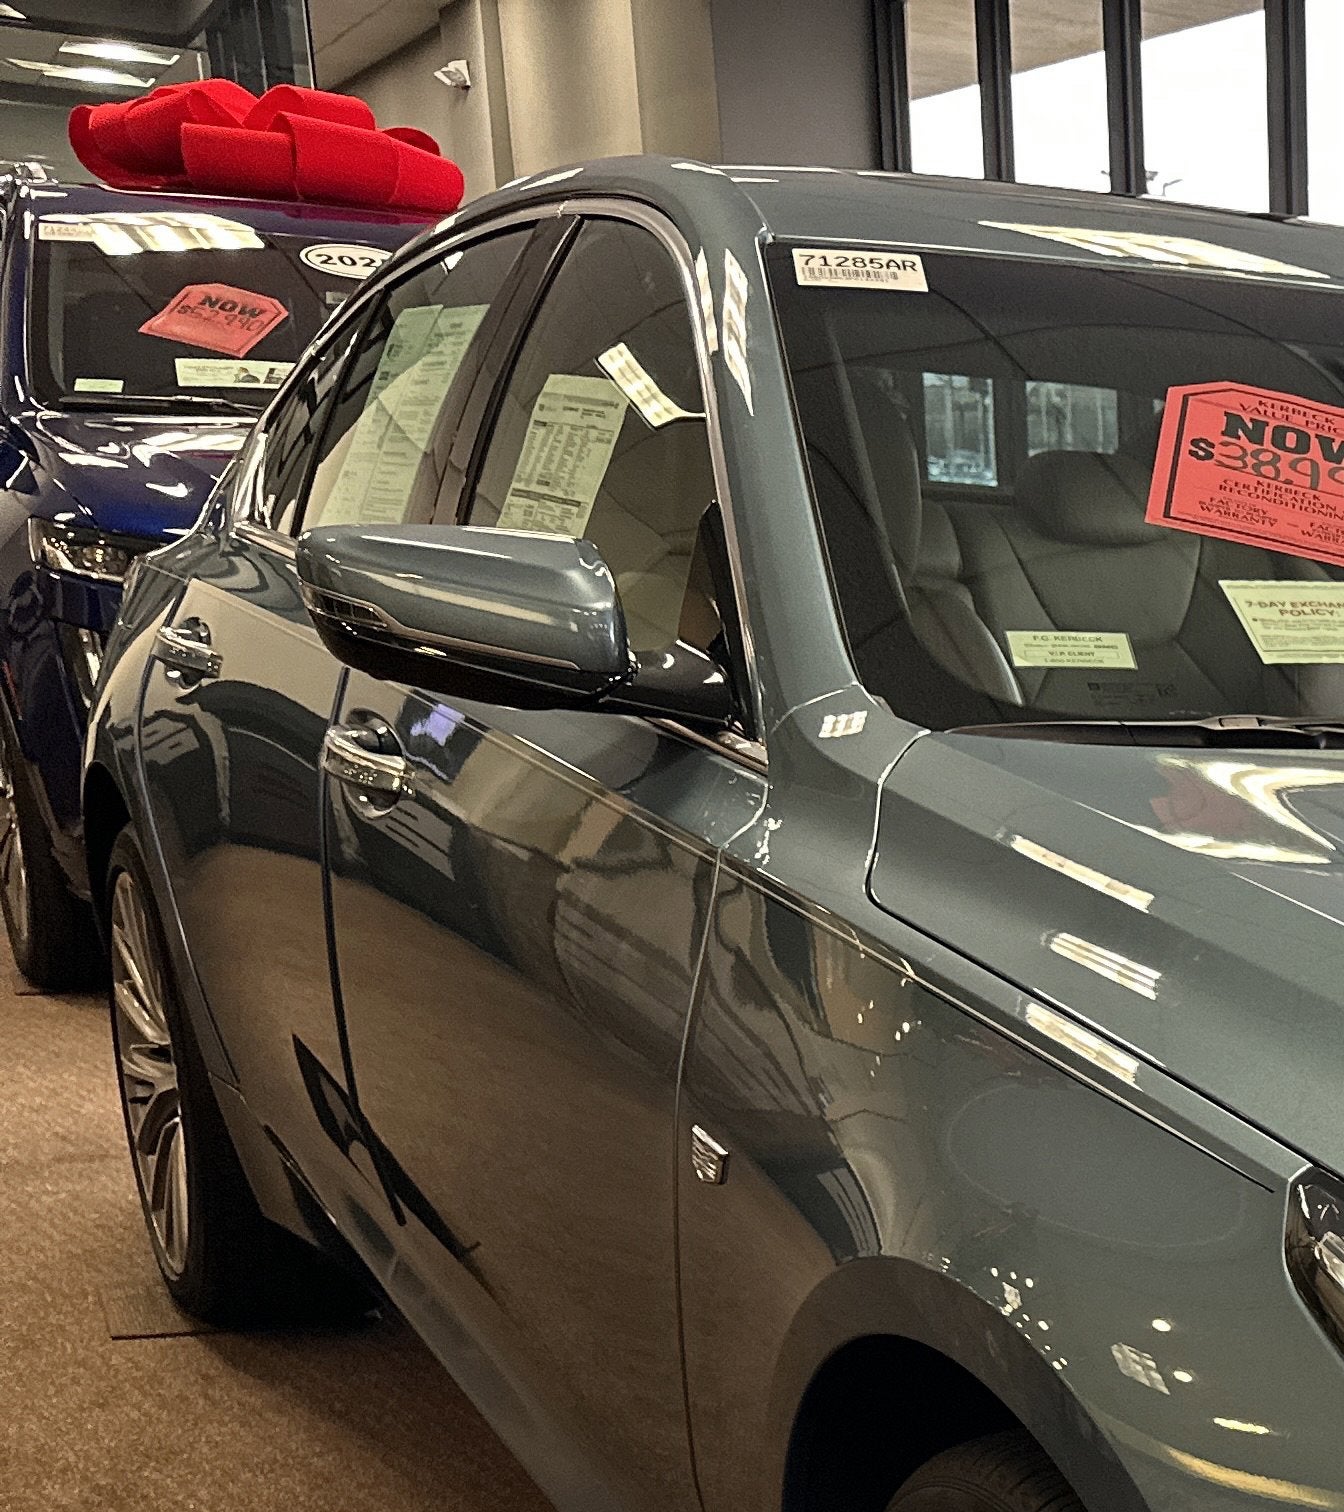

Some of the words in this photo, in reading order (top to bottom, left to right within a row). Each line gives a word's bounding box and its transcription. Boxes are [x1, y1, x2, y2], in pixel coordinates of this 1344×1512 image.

[316, 253, 383, 268] 202
[799, 254, 918, 272] 71285AR
[198, 295, 267, 319] NOW
[1239, 402, 1293, 421] VALUE
[1258, 400, 1335, 425] KERBECK
[1223, 479, 1337, 512] CERTIFICATION
[1256, 480, 1322, 502] KERBECK
[1200, 504, 1279, 527] WARRANTY
[1244, 600, 1287, 609] 7-DAY
